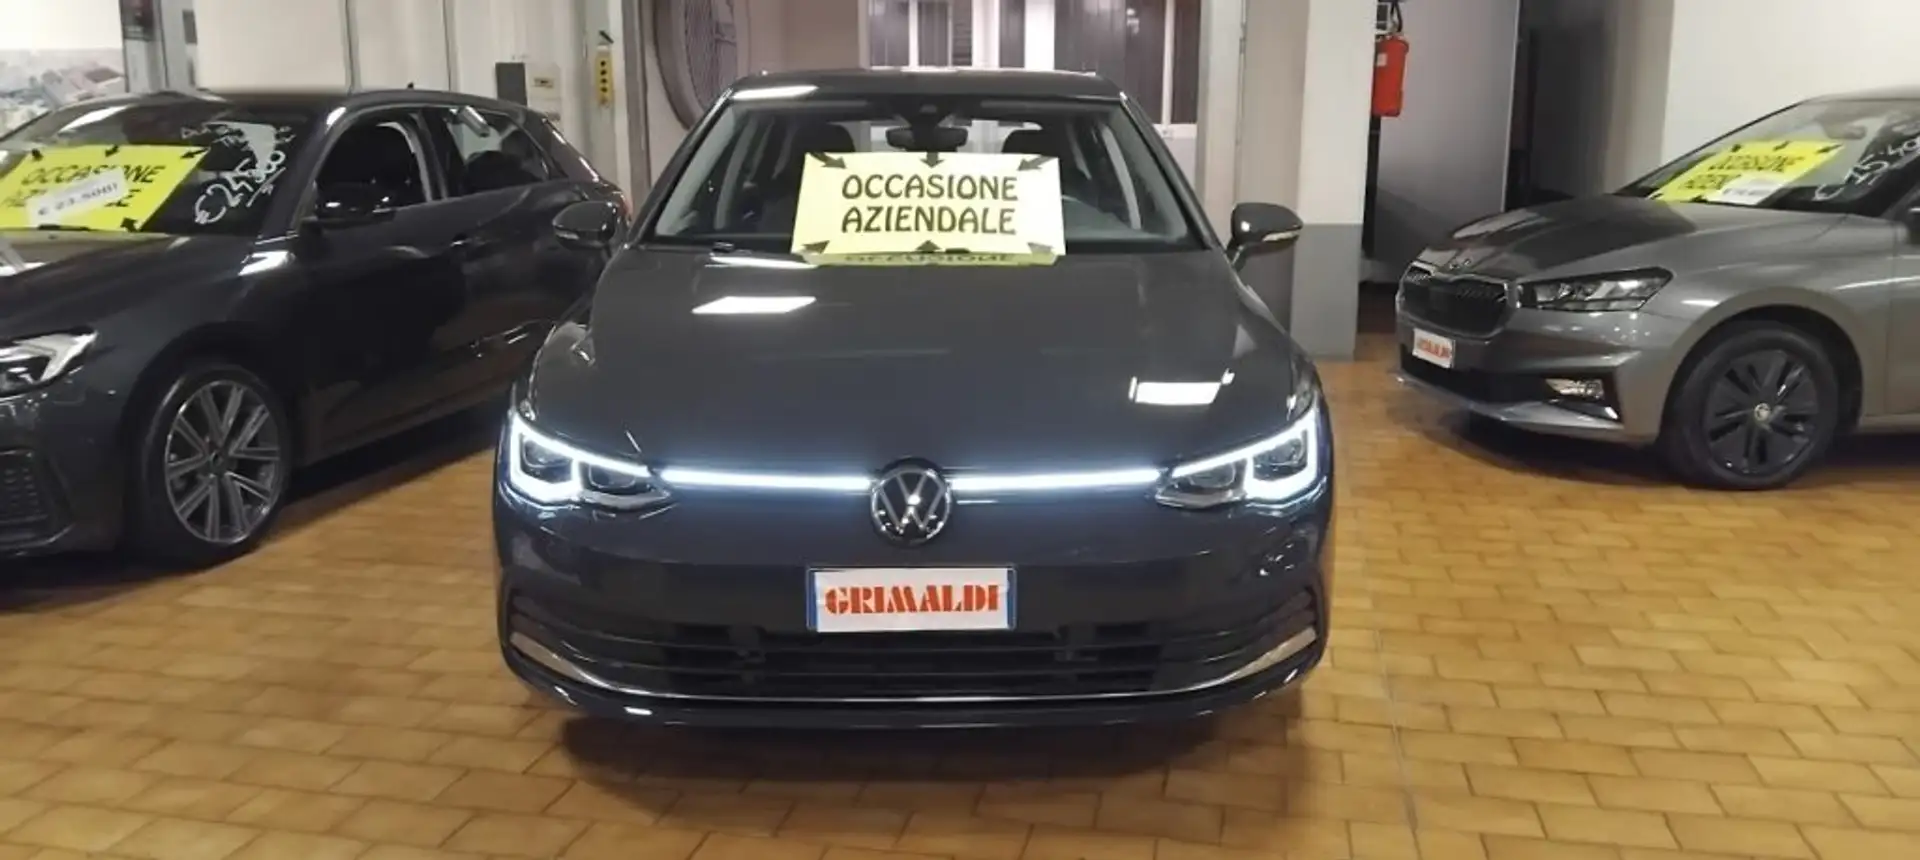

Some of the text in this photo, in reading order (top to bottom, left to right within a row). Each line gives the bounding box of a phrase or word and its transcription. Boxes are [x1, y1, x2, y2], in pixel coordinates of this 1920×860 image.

[841, 173, 1019, 201] OCCASIONE
[841, 205, 1017, 235] AZIENDALE
[825, 584, 1000, 615] GRIMALDI
